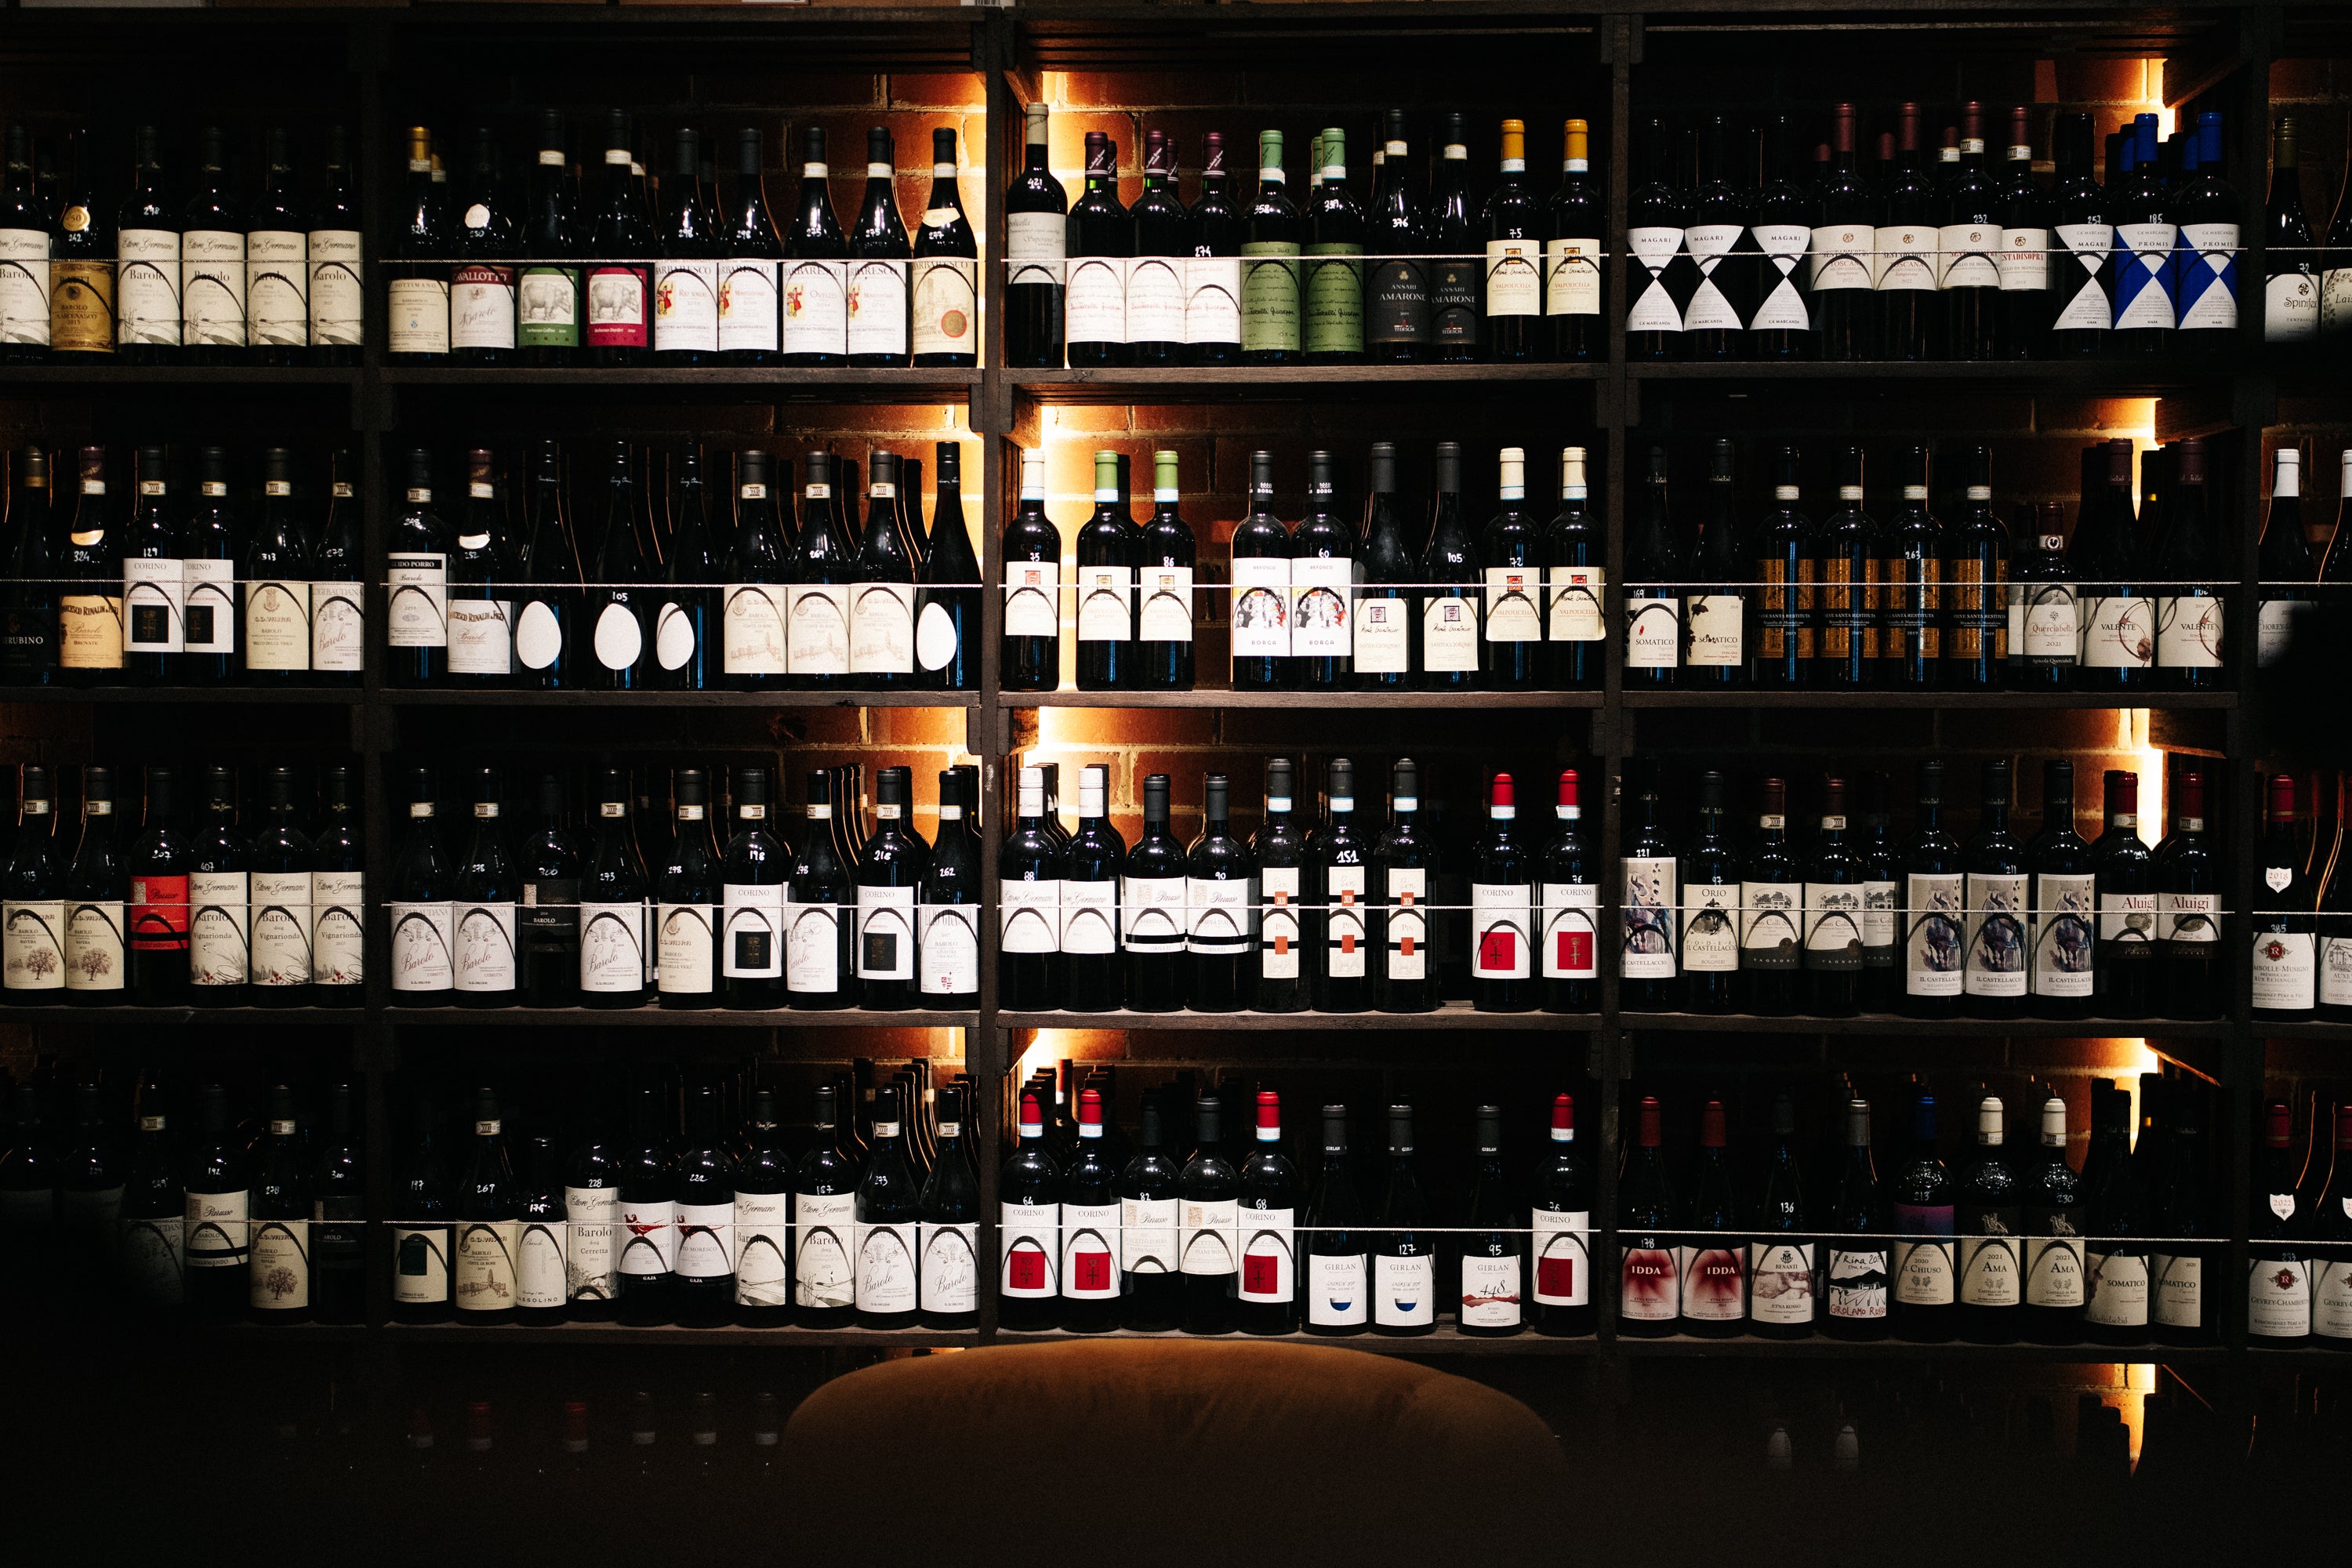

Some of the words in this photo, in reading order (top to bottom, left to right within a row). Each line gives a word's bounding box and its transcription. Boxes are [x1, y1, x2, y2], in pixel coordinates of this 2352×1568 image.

[1254, 204, 1269, 215] 358
[1392, 218, 1408, 227] 376
[1973, 214, 1987, 224] 232
[2087, 215, 2101, 224] 257
[2149, 213, 2162, 223] 185
[1509, 228, 1522, 238] 75
[141, 237, 174, 252] Germano
[1196, 245, 1211, 257] 274
[2299, 263, 2310, 274] 72
[130, 269, 164, 281] Barolo
[2283, 296, 2318, 310] Spinifex
[74, 550, 90, 562] 324
[143, 547, 158, 557] 129
[261, 553, 276, 561] 313
[1318, 547, 1330, 558] 60
[1904, 550, 1920, 560] 263
[1163, 556, 1174, 567] 86
[1447, 553, 1463, 563] 105
[1509, 557, 1523, 568] 72
[134, 562, 167, 571] CORINO
[612, 591, 628, 601] 105
[1633, 589, 1644, 598] 169
[1635, 637, 1674, 646] SOMATICO
[1698, 636, 1738, 644] SOMATICO
[750, 850, 766, 861] 198
[1336, 850, 1359, 862] 151
[1635, 848, 1650, 857] 221
[201, 862, 215, 872] 407
[472, 863, 485, 873] 278
[539, 867, 558, 876] 300
[669, 866, 683, 874] 278
[939, 867, 956, 877] 262
[2006, 865, 2016, 874] 211
[600, 872, 615, 881] 273
[1024, 871, 1035, 881] 88
[1214, 872, 1226, 880] 90
[1572, 876, 1582, 884] 76
[255, 880, 270, 892] Ettore
[272, 881, 306, 895] Germano
[316, 879, 332, 891] Ettore
[1702, 888, 1727, 898] ORIO
[1276, 896, 1287, 906] 2020
[1344, 894, 1354, 904] 2020
[1403, 896, 1413, 906] 2020
[2121, 896, 2155, 911] Aluigi
[2169, 895, 2209, 911] Aluigi
[261, 911, 297, 923] Barolo
[323, 910, 359, 922] Barolo
[2270, 924, 2286, 933] 385
[260, 931, 300, 941] Vignarionda
[321, 931, 362, 940] Vignarionda
[401, 944, 434, 975] Barolo
[465, 944, 492, 973] Barolo
[587, 944, 620, 975] Barolo
[209, 1167, 221, 1175] 192
[412, 1180, 424, 1191] 197
[589, 1178, 603, 1188] 228
[874, 1176, 887, 1186] 273
[266, 1185, 280, 1195] 278
[571, 1193, 590, 1207] Ettore
[1022, 1196, 1034, 1205] 64
[1139, 1192, 1152, 1201] 82
[1914, 1192, 1929, 1201] 213
[2056, 1194, 2073, 1203] 230
[742, 1201, 776, 1215] Germano
[802, 1202, 818, 1213] Ettore
[819, 1201, 851, 1217] Germano
[1255, 1199, 1267, 1209] 68
[1780, 1203, 1794, 1212] 136
[204, 1205, 234, 1217] Parusso
[1541, 1214, 1571, 1223] CORINO
[578, 1227, 613, 1237] Barolo
[810, 1235, 843, 1245] Barolo
[1641, 1238, 1654, 1248] 178
[1399, 1244, 1416, 1254] 127
[1489, 1244, 1501, 1255] 95
[1844, 1255, 1867, 1264] Rina
[1632, 1265, 1661, 1275] IDDA
[1707, 1267, 1736, 1276] IDDA
[1911, 1264, 1941, 1273] CHIUSO
[1982, 1261, 2008, 1272] AMA
[2050, 1262, 2075, 1274] AMA
[863, 1265, 893, 1296] Barolo
[935, 1265, 967, 1297] Barolo
[1480, 1279, 1506, 1297] 448
[1830, 1304, 1866, 1316] GIROLAMO
